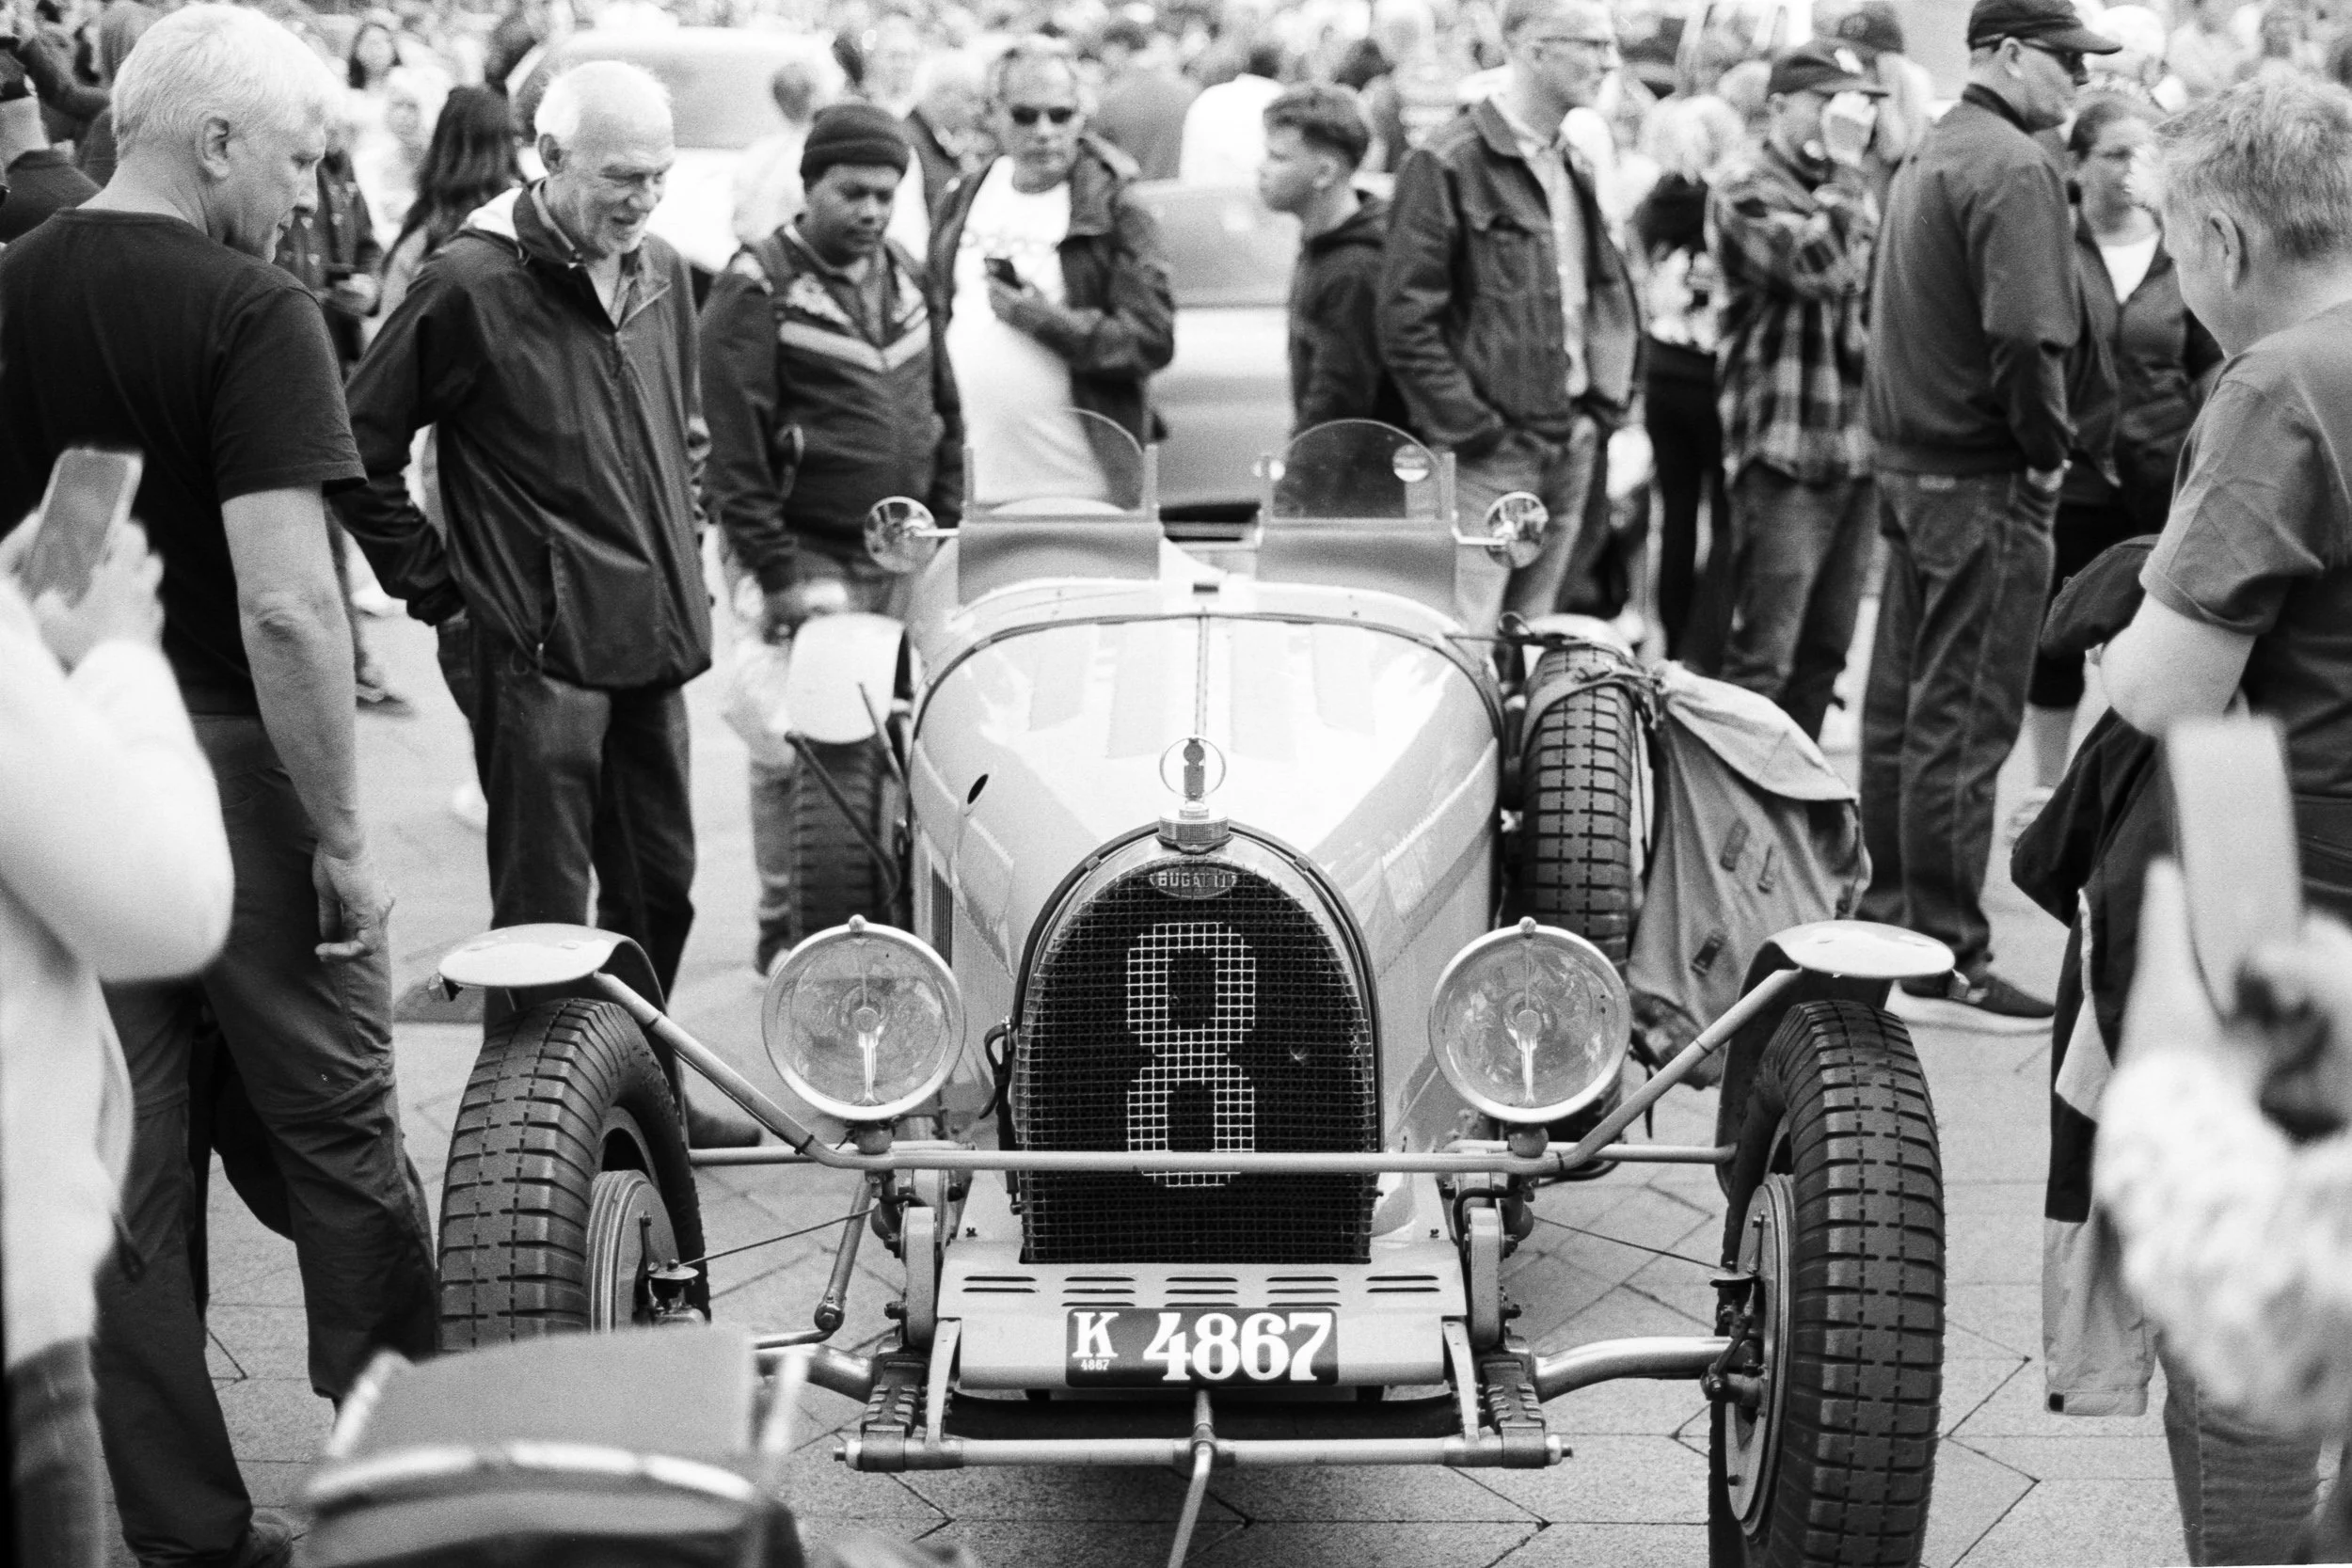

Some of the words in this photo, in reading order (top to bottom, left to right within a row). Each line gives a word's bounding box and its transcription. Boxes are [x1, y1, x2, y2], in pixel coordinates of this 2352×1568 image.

[1126, 922, 1255, 1187] 8
[1072, 1311, 1120, 1357] K
[1143, 1311, 1332, 1381] 4867
[1081, 1358, 1110, 1370] 4867
